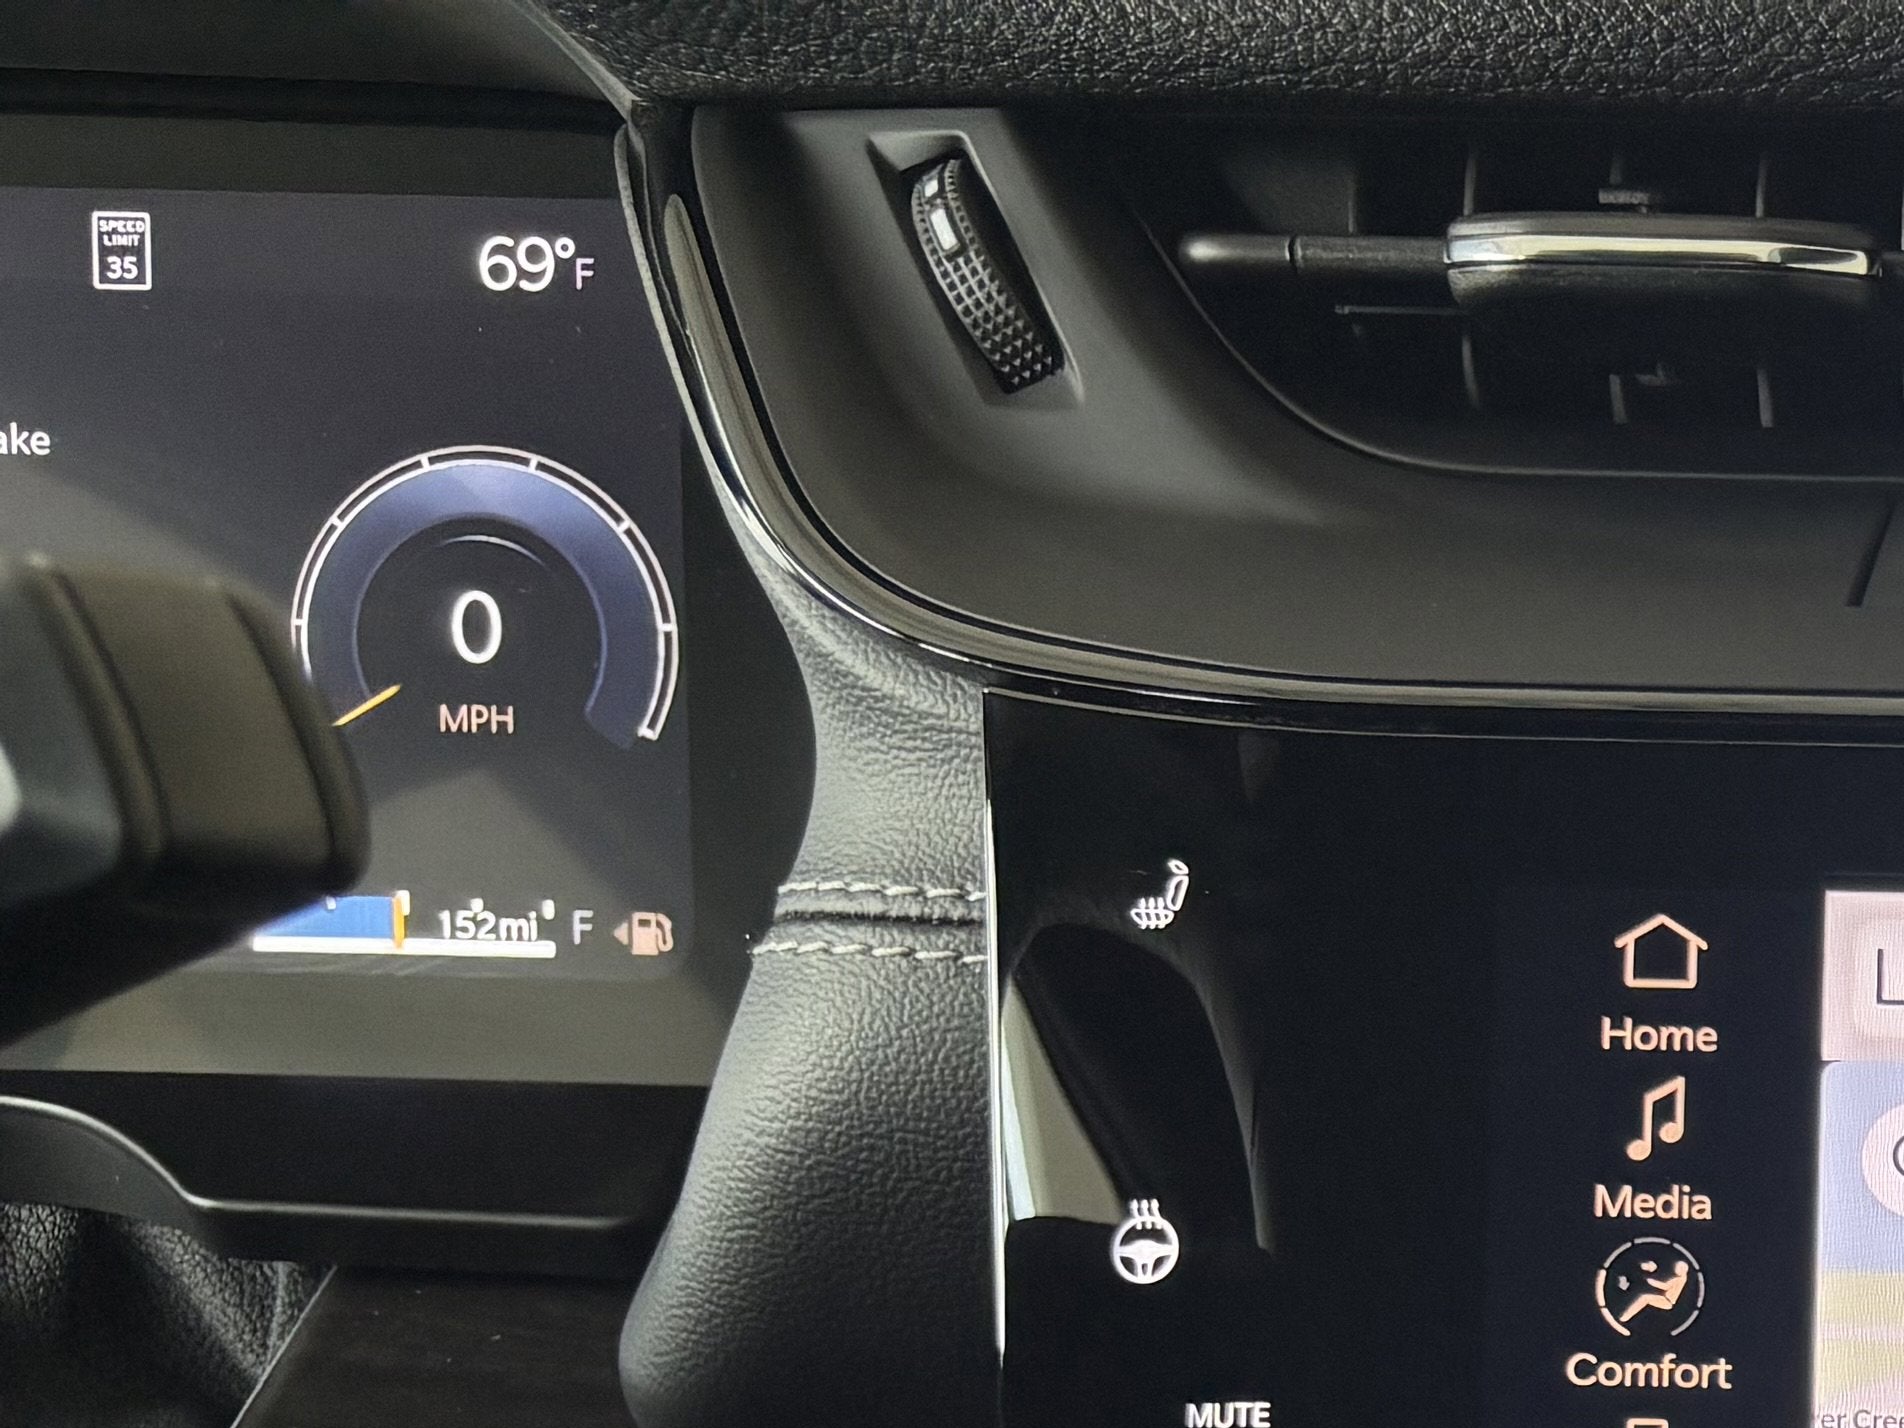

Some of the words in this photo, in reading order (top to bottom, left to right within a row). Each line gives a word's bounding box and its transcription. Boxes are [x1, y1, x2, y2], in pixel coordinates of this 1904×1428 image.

[98, 219, 146, 233] SPEED
[102, 233, 141, 247] LIMIT
[105, 255, 139, 280] 35
[450, 589, 503, 664] 0
[438, 704, 515, 735] MPH
[572, 908, 595, 946] F
[1600, 1016, 1719, 1054] Home
[1593, 1184, 1713, 1221] Media
[1565, 1352, 1733, 1390] Comfort
